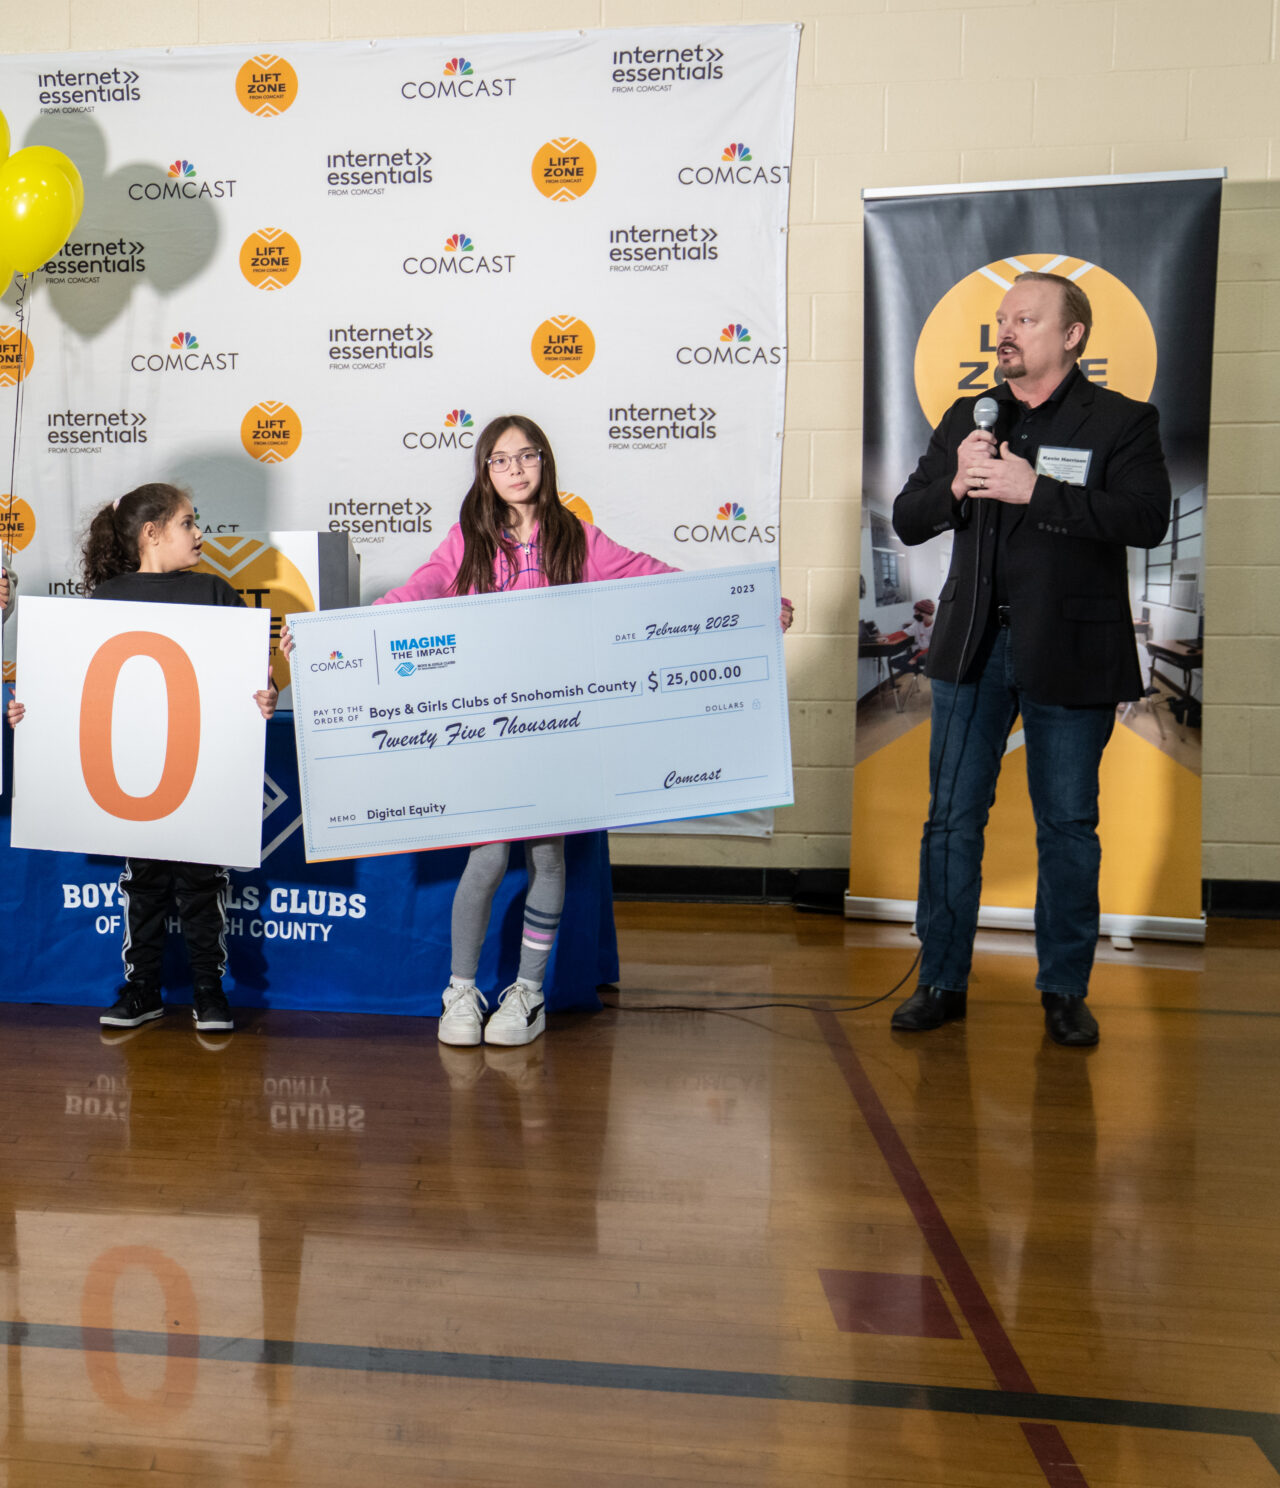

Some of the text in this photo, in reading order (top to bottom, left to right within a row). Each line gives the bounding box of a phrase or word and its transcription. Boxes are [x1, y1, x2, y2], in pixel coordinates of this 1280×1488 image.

[612, 44, 703, 65] internet
[38, 67, 121, 88] internet
[252, 73, 282, 83] LIFT
[612, 61, 723, 83] essentials
[38, 84, 141, 104] essentials
[247, 83, 286, 93] ZONE
[401, 78, 516, 100] COMCAST
[612, 84, 672, 93] FROM COMCAST
[62, 106, 95, 114] COMCAST
[327, 149, 413, 169] internet
[549, 156, 580, 167] LIFT
[327, 165, 433, 186] essentials
[543, 167, 584, 178] ZONE
[128, 180, 237, 201] COMCAST
[328, 188, 385, 197] FROM COMCAST
[609, 224, 698, 244] internet
[256, 247, 286, 257] LIFT
[609, 242, 718, 262] essentials
[45, 255, 146, 275] essentials
[251, 257, 290, 268] ZONE
[402, 255, 516, 276] COMCAST
[633, 264, 669, 272] COMCAST
[328, 324, 414, 343] internet
[548, 334, 580, 344] LIFT
[328, 341, 434, 360] essentials
[543, 345, 584, 355] ZONE
[676, 346, 786, 365] COMCAS
[131, 352, 239, 372] COMCAST
[351, 362, 386, 370] COMCAST
[47, 409, 129, 427] internet
[608, 403, 696, 422] internet
[257, 420, 286, 430] LIFT
[608, 421, 717, 440] essentials
[47, 426, 148, 444] essentials
[252, 430, 290, 440] ZONE
[328, 498, 414, 517] internet
[328, 514, 433, 534] essentials
[673, 524, 780, 544] COMCAS
[730, 584, 755, 595] 2023
[615, 613, 740, 642] DATE February 2023
[390, 633, 457, 652] IMAGINE
[391, 646, 457, 660] THE IMPACT
[310, 658, 364, 673] COMCAST
[369, 665, 742, 720] Boys & Girls Clubs of Snohomish County $ 25,000.00
[313, 705, 364, 717] PAY TO THE
[705, 701, 745, 713] DOLLARS
[78, 630, 201, 822] 0
[314, 714, 359, 725] ORDER OF
[371, 710, 582, 750] Twenty Five Thousand
[663, 767, 722, 789] Comcast
[329, 803, 447, 823] MEMO Digital Equity
[270, 887, 367, 919] CLUBS
[95, 915, 121, 934] OF
[250, 919, 333, 942] COUNTY
